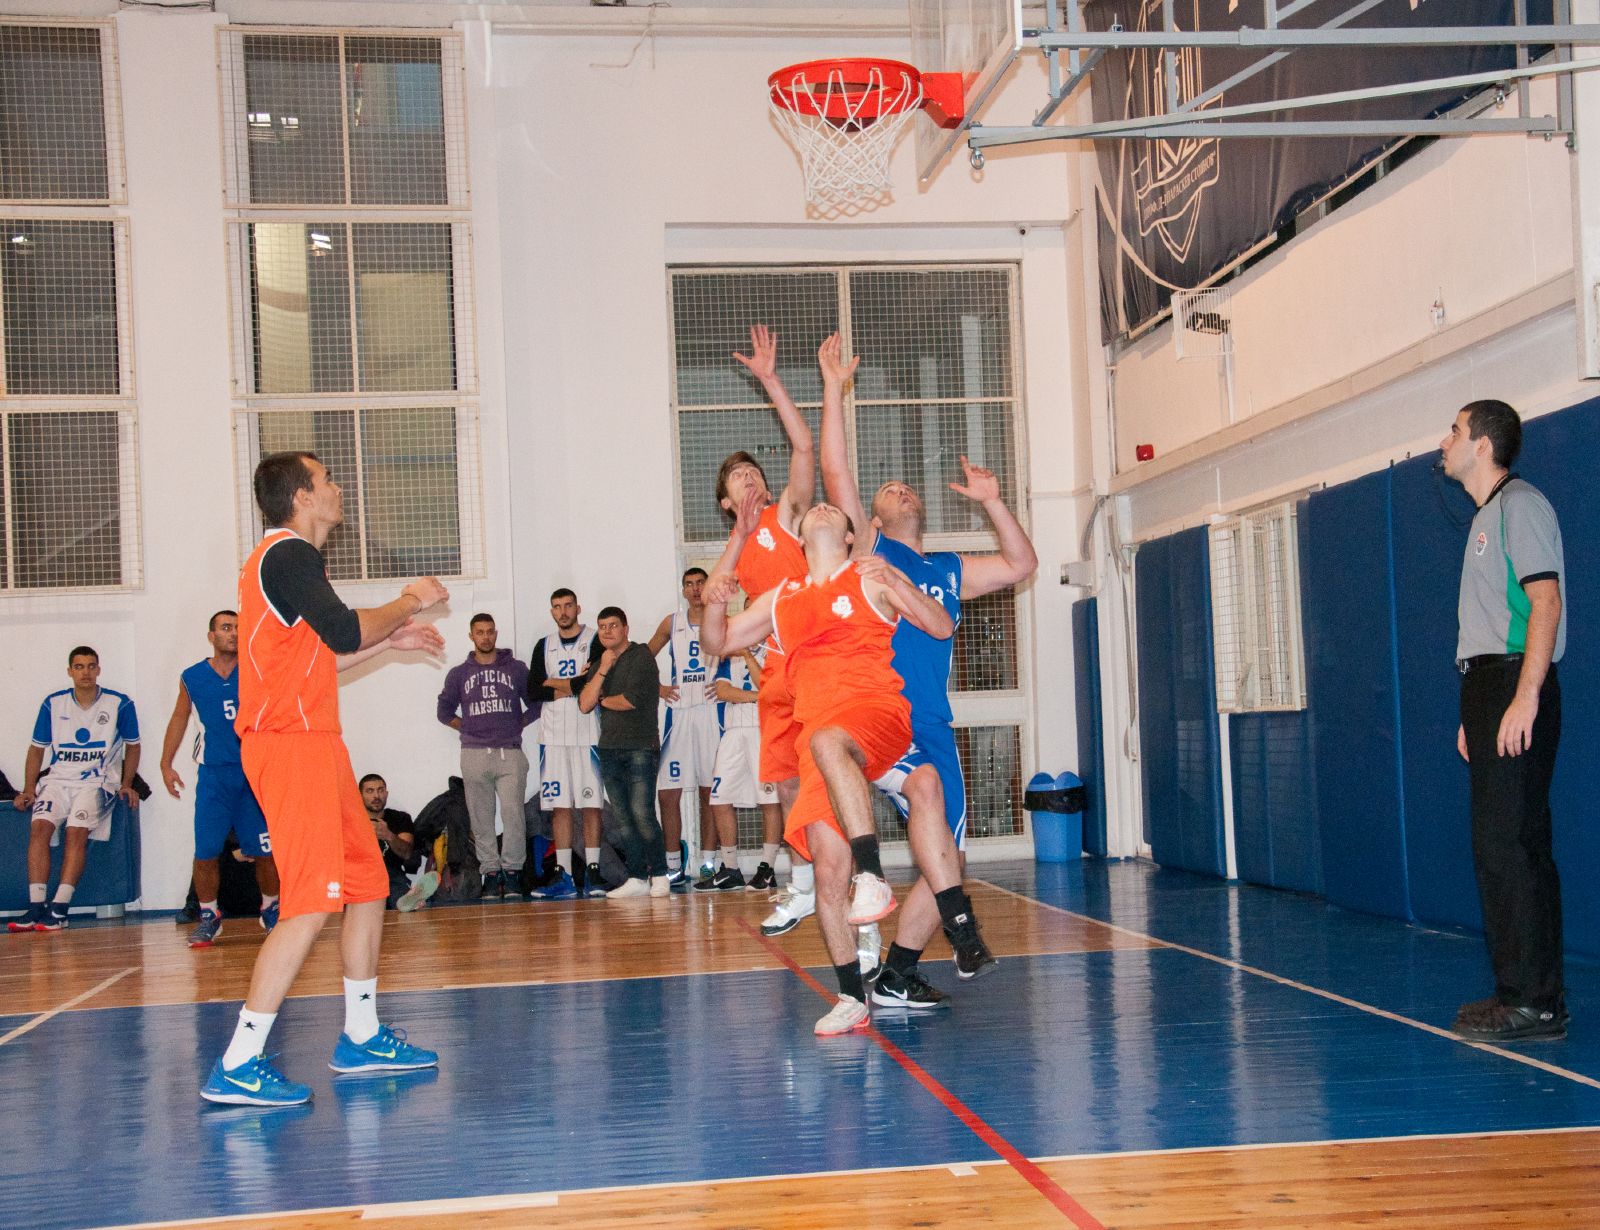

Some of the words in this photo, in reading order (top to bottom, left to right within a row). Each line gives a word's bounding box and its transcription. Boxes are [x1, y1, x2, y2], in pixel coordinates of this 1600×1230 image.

[689, 640, 700, 657] 6
[558, 658, 577, 677] 23
[481, 685, 498, 699] U.S.
[223, 700, 237, 720] 5
[57, 750, 106, 762] СИБАНК
[669, 761, 681, 778] 6
[542, 781, 561, 798] 23
[711, 777, 721, 794] 7
[33, 800, 53, 814] 21
[258, 832, 272, 853] 5
